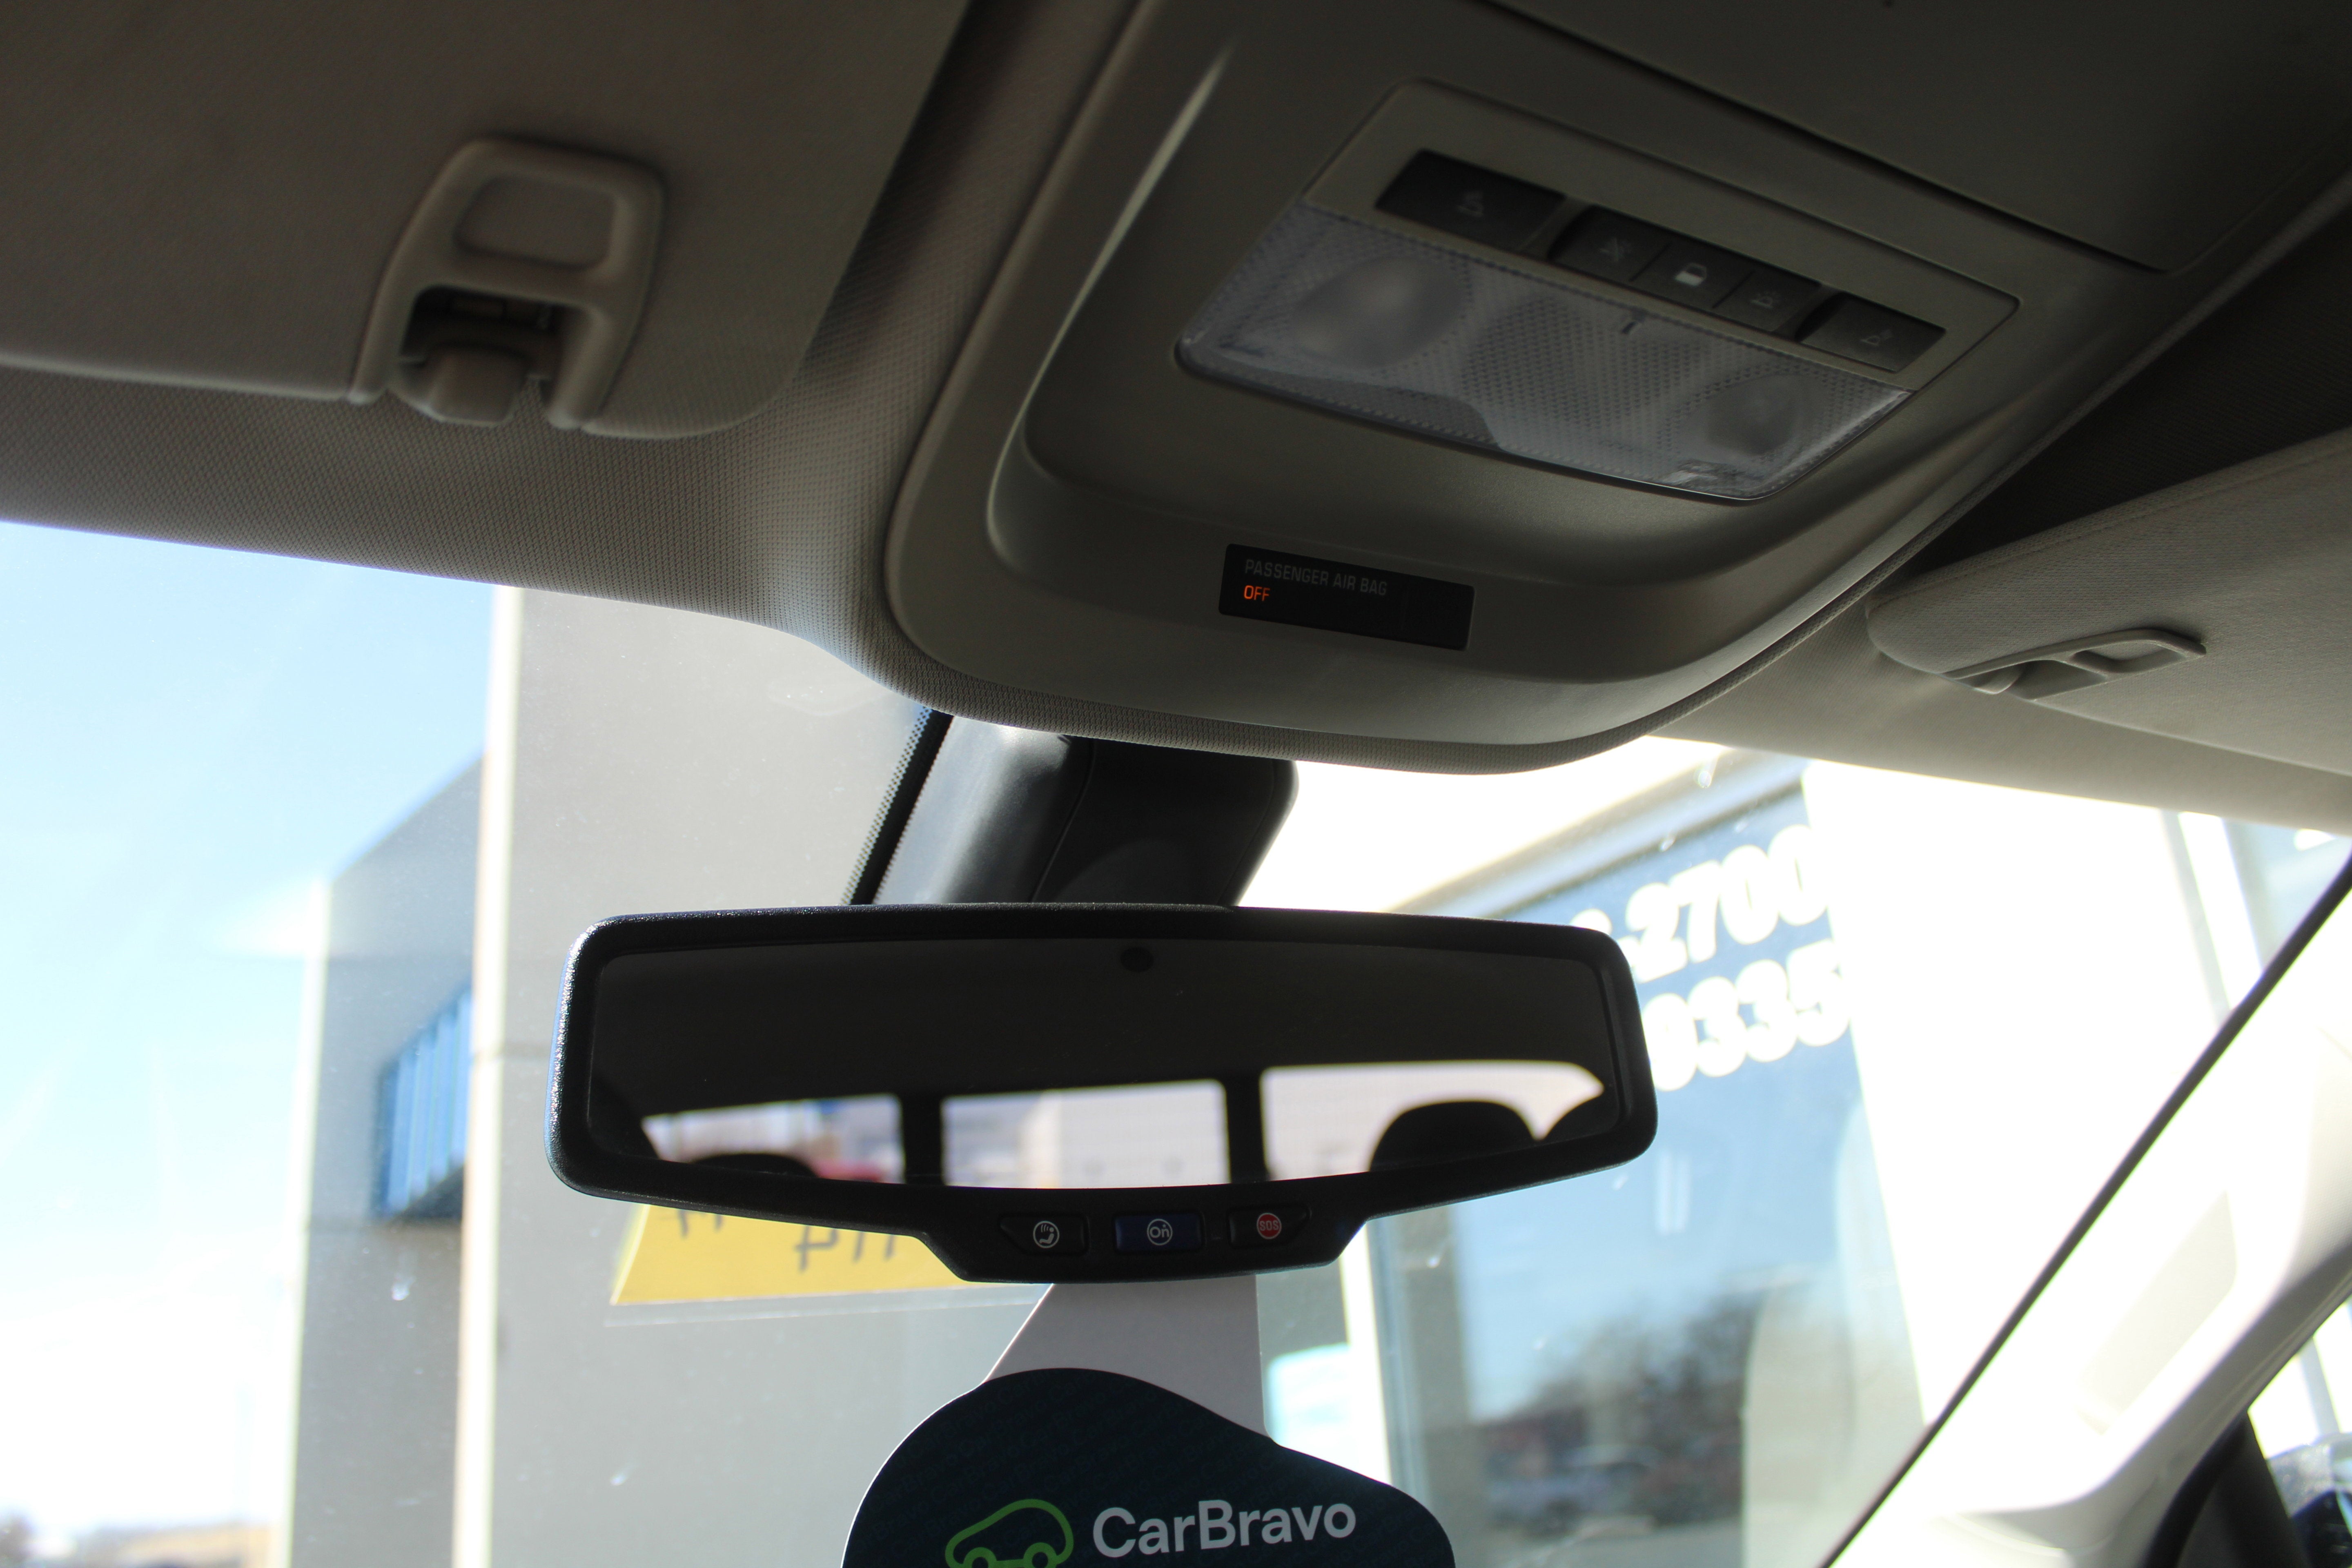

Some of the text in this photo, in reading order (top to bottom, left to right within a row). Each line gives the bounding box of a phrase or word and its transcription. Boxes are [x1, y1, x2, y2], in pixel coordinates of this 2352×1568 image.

[1245, 559, 1387, 595] PASSENGER AIR BAG
[1243, 585, 1271, 601] OFF
[1259, 1219, 1279, 1232] SOS
[1093, 1499, 1356, 1558] CarBravo
